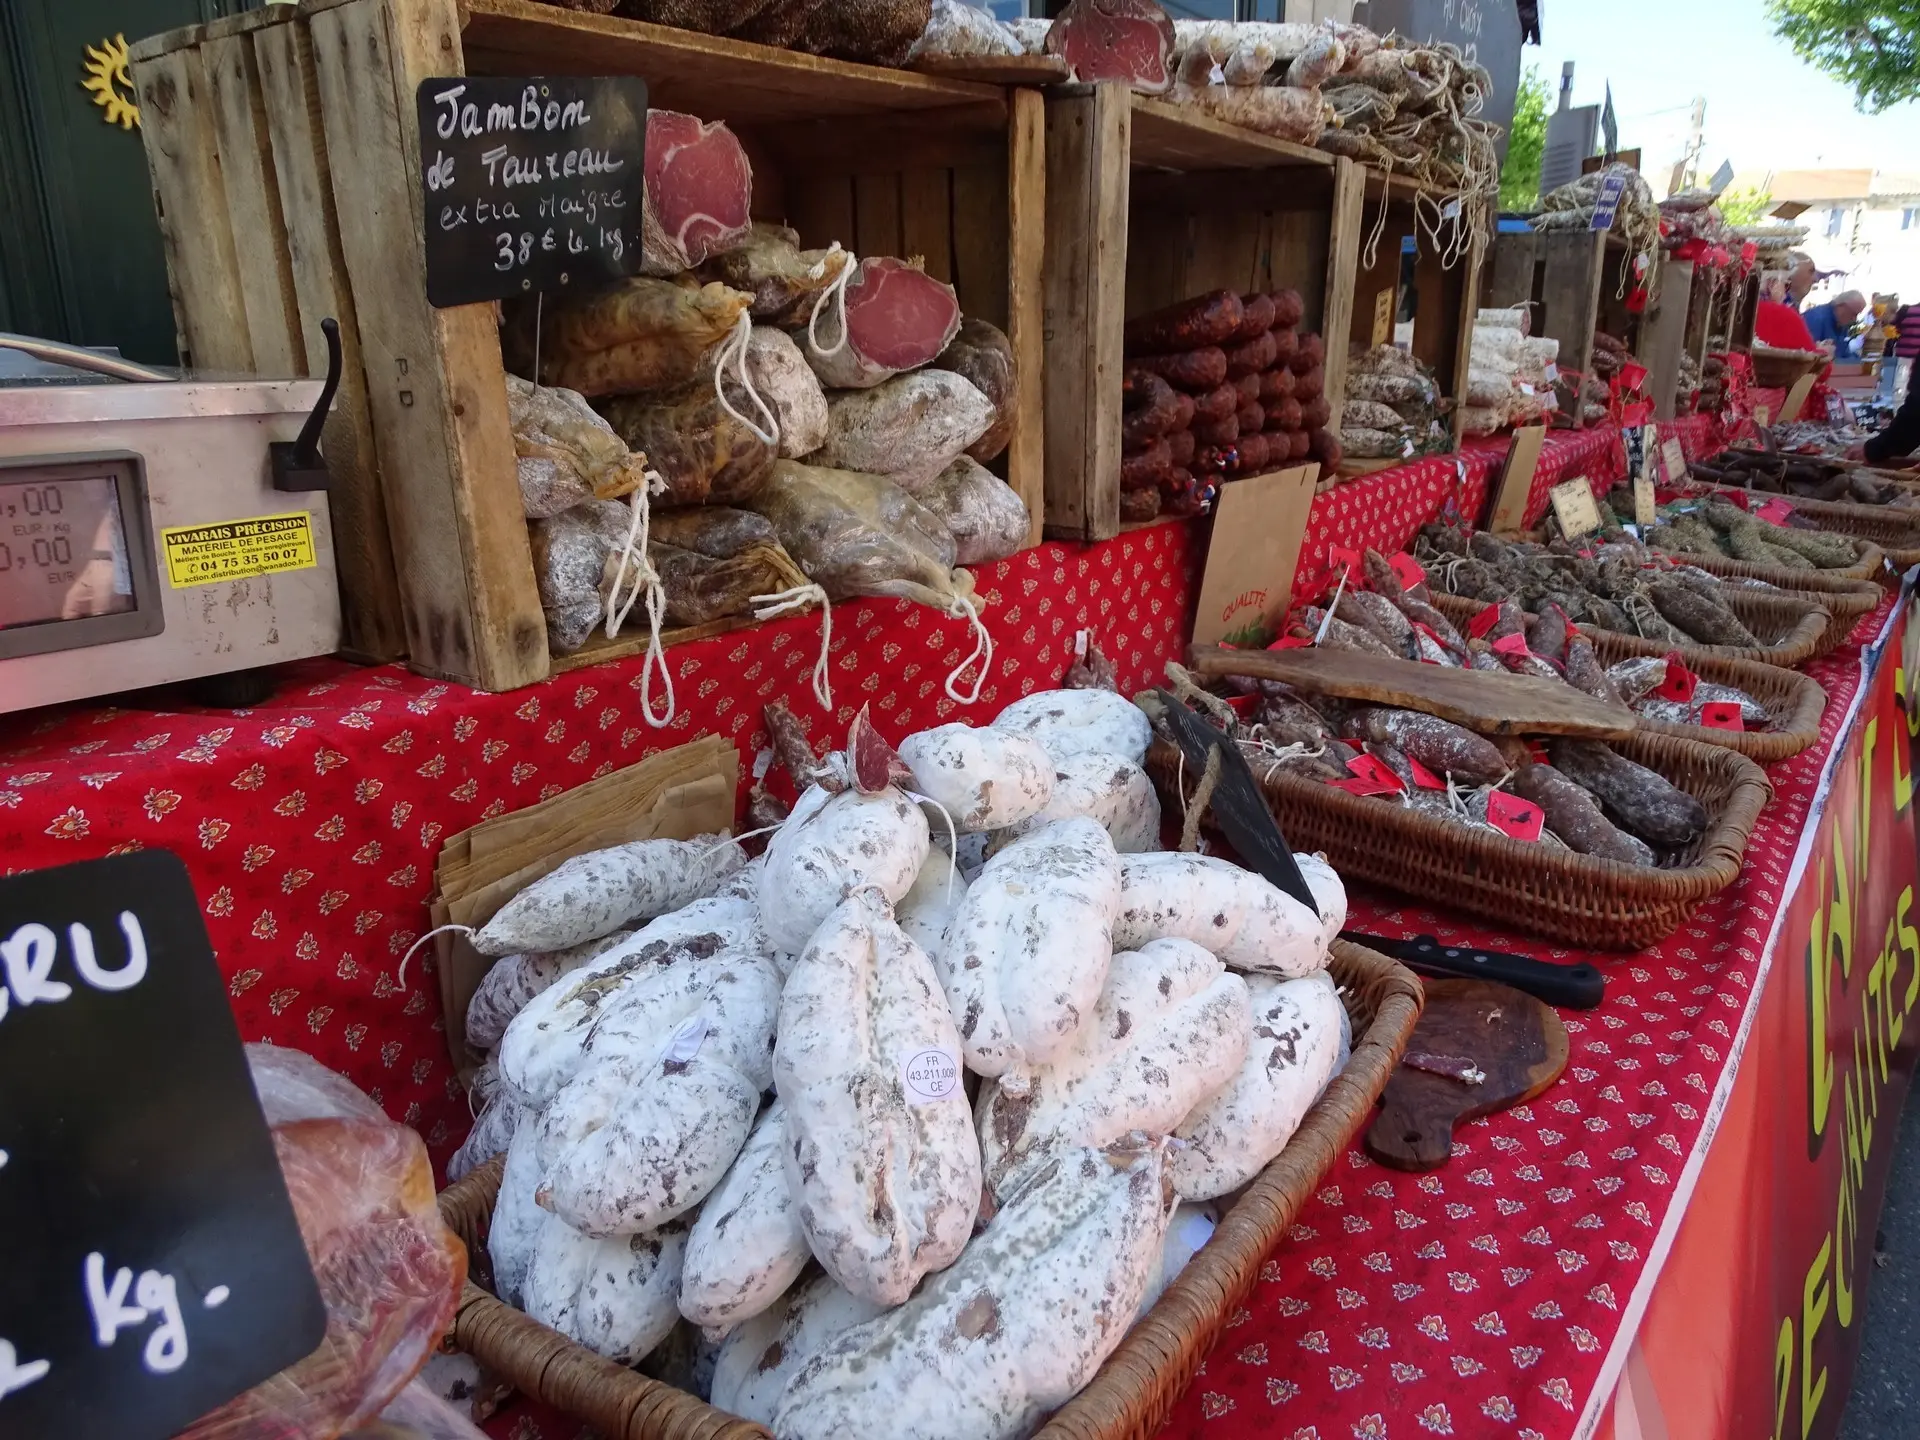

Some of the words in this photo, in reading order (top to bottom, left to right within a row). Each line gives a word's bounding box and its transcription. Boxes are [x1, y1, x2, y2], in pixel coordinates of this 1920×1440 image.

[427, 150, 455, 191] de
[481, 144, 624, 188] Taureau
[440, 197, 520, 230] extra
[13, 523, 43, 536] EUR
[167, 527, 232, 545] VIVARAIS
[234, 518, 306, 537] PRÉCISION
[175, 555, 200, 564] Métiers
[211, 550, 236, 559] Bouche
[264, 540, 306, 550] enregistreuse
[181, 541, 236, 556] MATÉRIEL
[239, 537, 254, 547] DE
[256, 531, 298, 545] PESAGE
[184, 558, 304, 583] action.distribution@wanadoo.fr
[200, 560, 217, 572] 04
[222, 557, 238, 568] 75
[243, 554, 259, 565] 35
[263, 551, 279, 562] 50
[282, 548, 298, 559] 07
[47, 571, 76, 584] EUR
[0, 910, 148, 1021] RU
[926, 1055, 939, 1067] FR
[931, 1081, 943, 1092] CE
